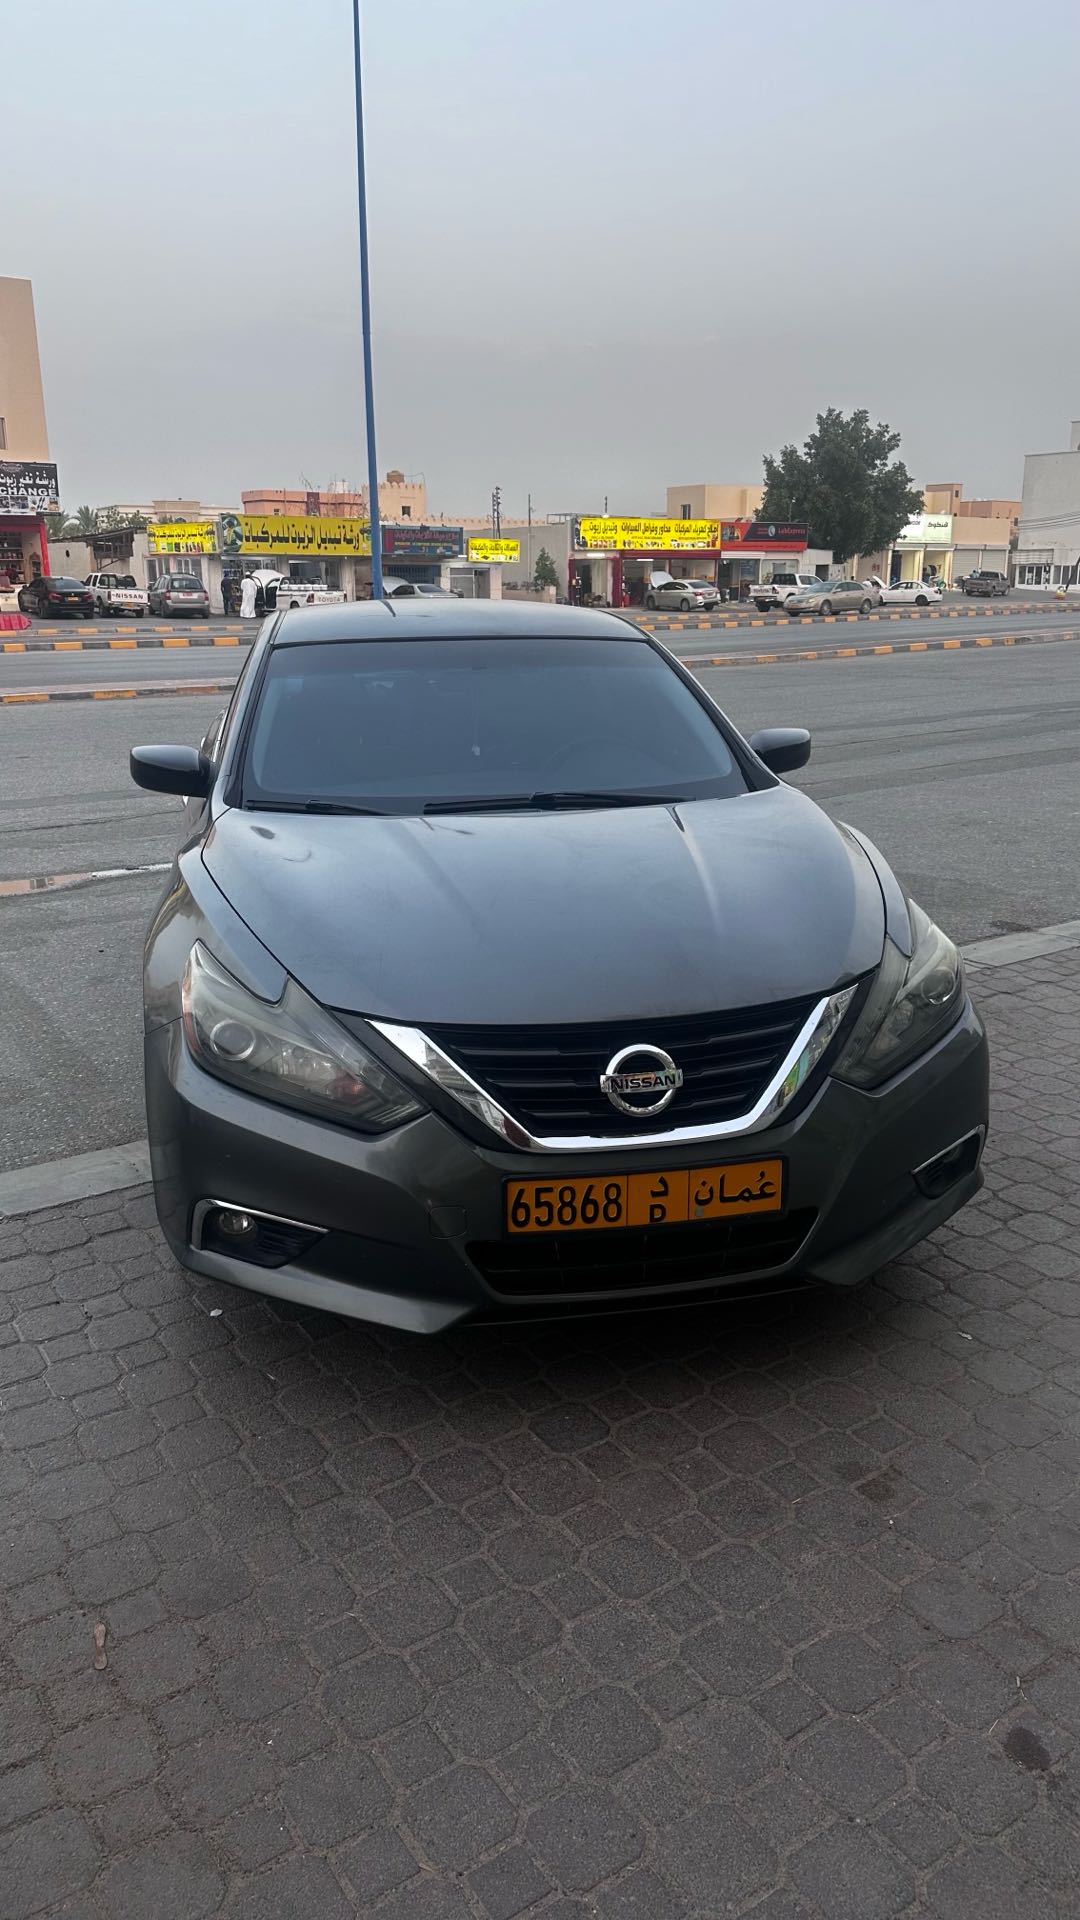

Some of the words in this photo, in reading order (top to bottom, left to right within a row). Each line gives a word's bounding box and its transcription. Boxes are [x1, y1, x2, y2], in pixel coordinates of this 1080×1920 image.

[0, 487, 57, 497] CHANGE
[245, 522, 290, 549] للمركبات
[291, 524, 316, 550] الزيوت
[317, 525, 342, 550] تبديل
[343, 525, 360, 550] ورشة
[116, 592, 144, 600] NISSAN
[610, 1074, 677, 1092] NISSAN
[511, 1182, 622, 1229] 65868
[650, 1176, 669, 1198] د
[649, 1204, 666, 1224] D
